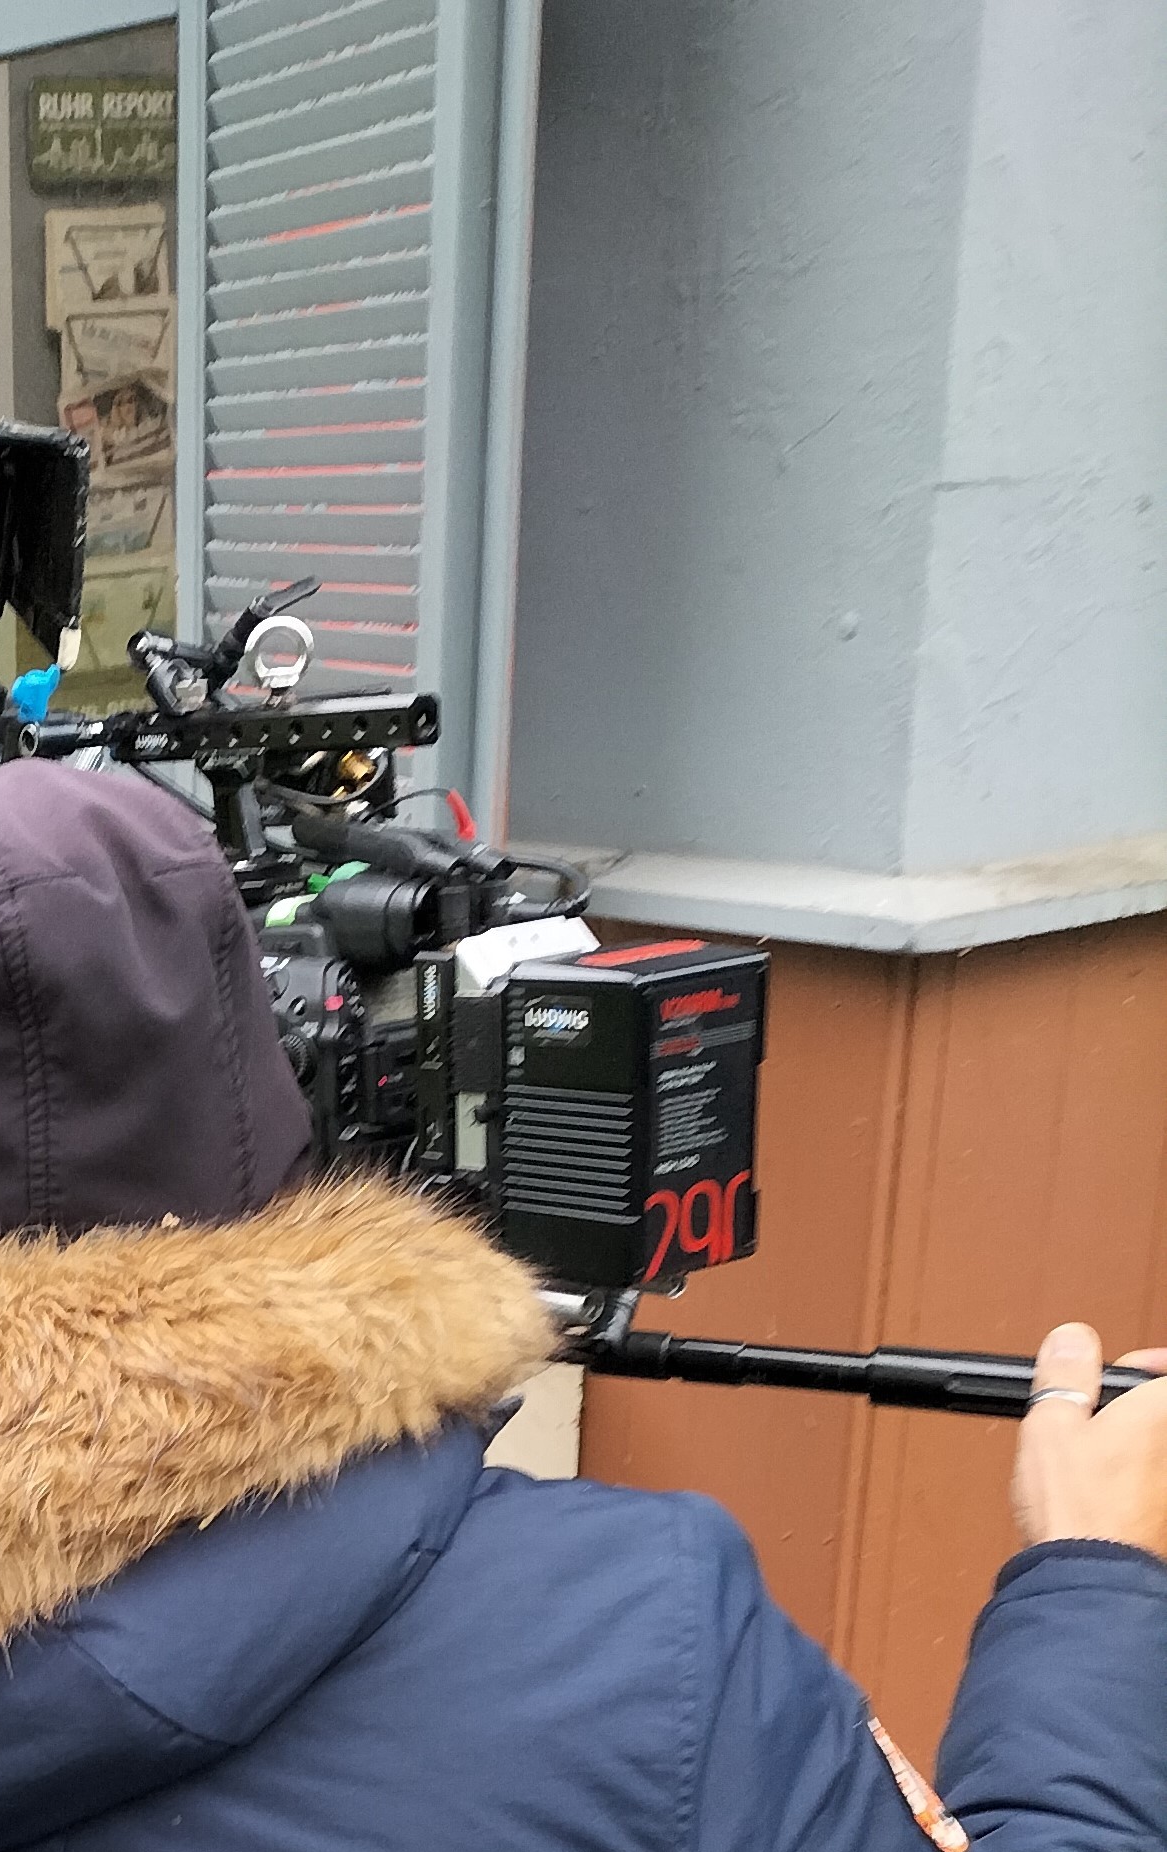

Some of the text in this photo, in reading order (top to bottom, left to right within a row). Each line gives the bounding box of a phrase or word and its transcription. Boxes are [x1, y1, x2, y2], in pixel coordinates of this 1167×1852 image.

[39, 90, 176, 120] RUHR REPORT
[524, 1007, 590, 1030] LUDWIG
